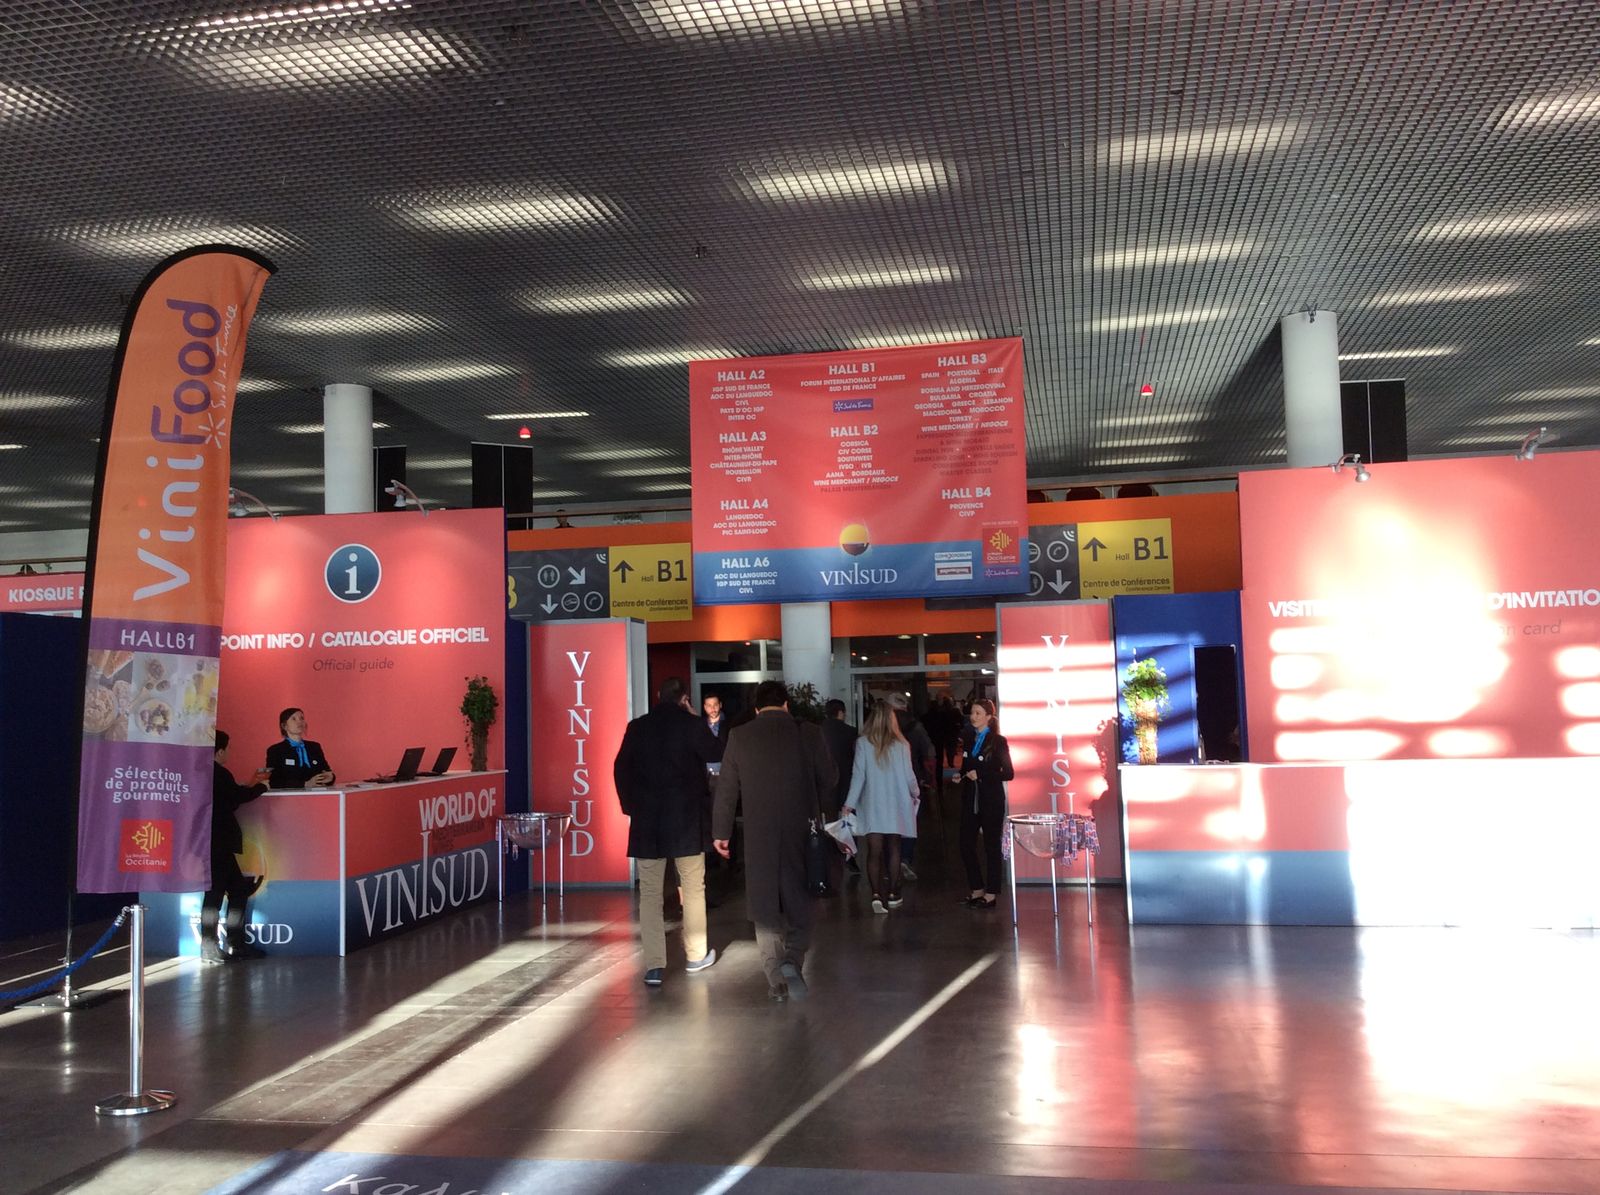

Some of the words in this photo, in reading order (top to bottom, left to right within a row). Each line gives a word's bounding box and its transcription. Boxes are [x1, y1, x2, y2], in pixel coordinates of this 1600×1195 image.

[938, 356, 968, 366] HALL
[972, 354, 986, 364] B3
[718, 371, 746, 381] HALL
[749, 370, 765, 380] A2
[829, 364, 858, 375] HALL
[862, 363, 875, 373] B1
[831, 426, 860, 437] HALL
[864, 425, 878, 435] B2
[939, 423, 973, 431] MERCHANT
[720, 432, 747, 443] HALL
[751, 431, 766, 441] A3
[133, 298, 222, 601] ViniFood
[942, 488, 968, 499] HALL
[975, 487, 991, 497] B4
[721, 500, 750, 510] HALL
[752, 499, 768, 508] A4
[1134, 537, 1168, 560] B1
[722, 558, 751, 568] HALL
[754, 557, 770, 567] A6
[657, 559, 687, 582] B1
[820, 563, 897, 586] VINISUD
[1121, 577, 1169, 586] Conférences
[9, 586, 74, 602] KIOSQUE
[1523, 618, 1562, 635] card
[220, 634, 262, 650] POINT
[267, 633, 304, 650] INFO
[308, 634, 315, 648] /
[321, 629, 416, 648] CATALOGUE
[419, 627, 489, 644] OFFICIEL
[312, 658, 356, 672] Official
[359, 658, 394, 671] guide
[566, 652, 594, 857] VINISUD
[115, 766, 182, 781] Sélection
[105, 778, 124, 789] de
[130, 780, 189, 793] produits
[113, 791, 181, 804] gourmets
[419, 792, 476, 831] WORLD
[478, 787, 496, 818] OF
[355, 831, 488, 937] VINISUD
